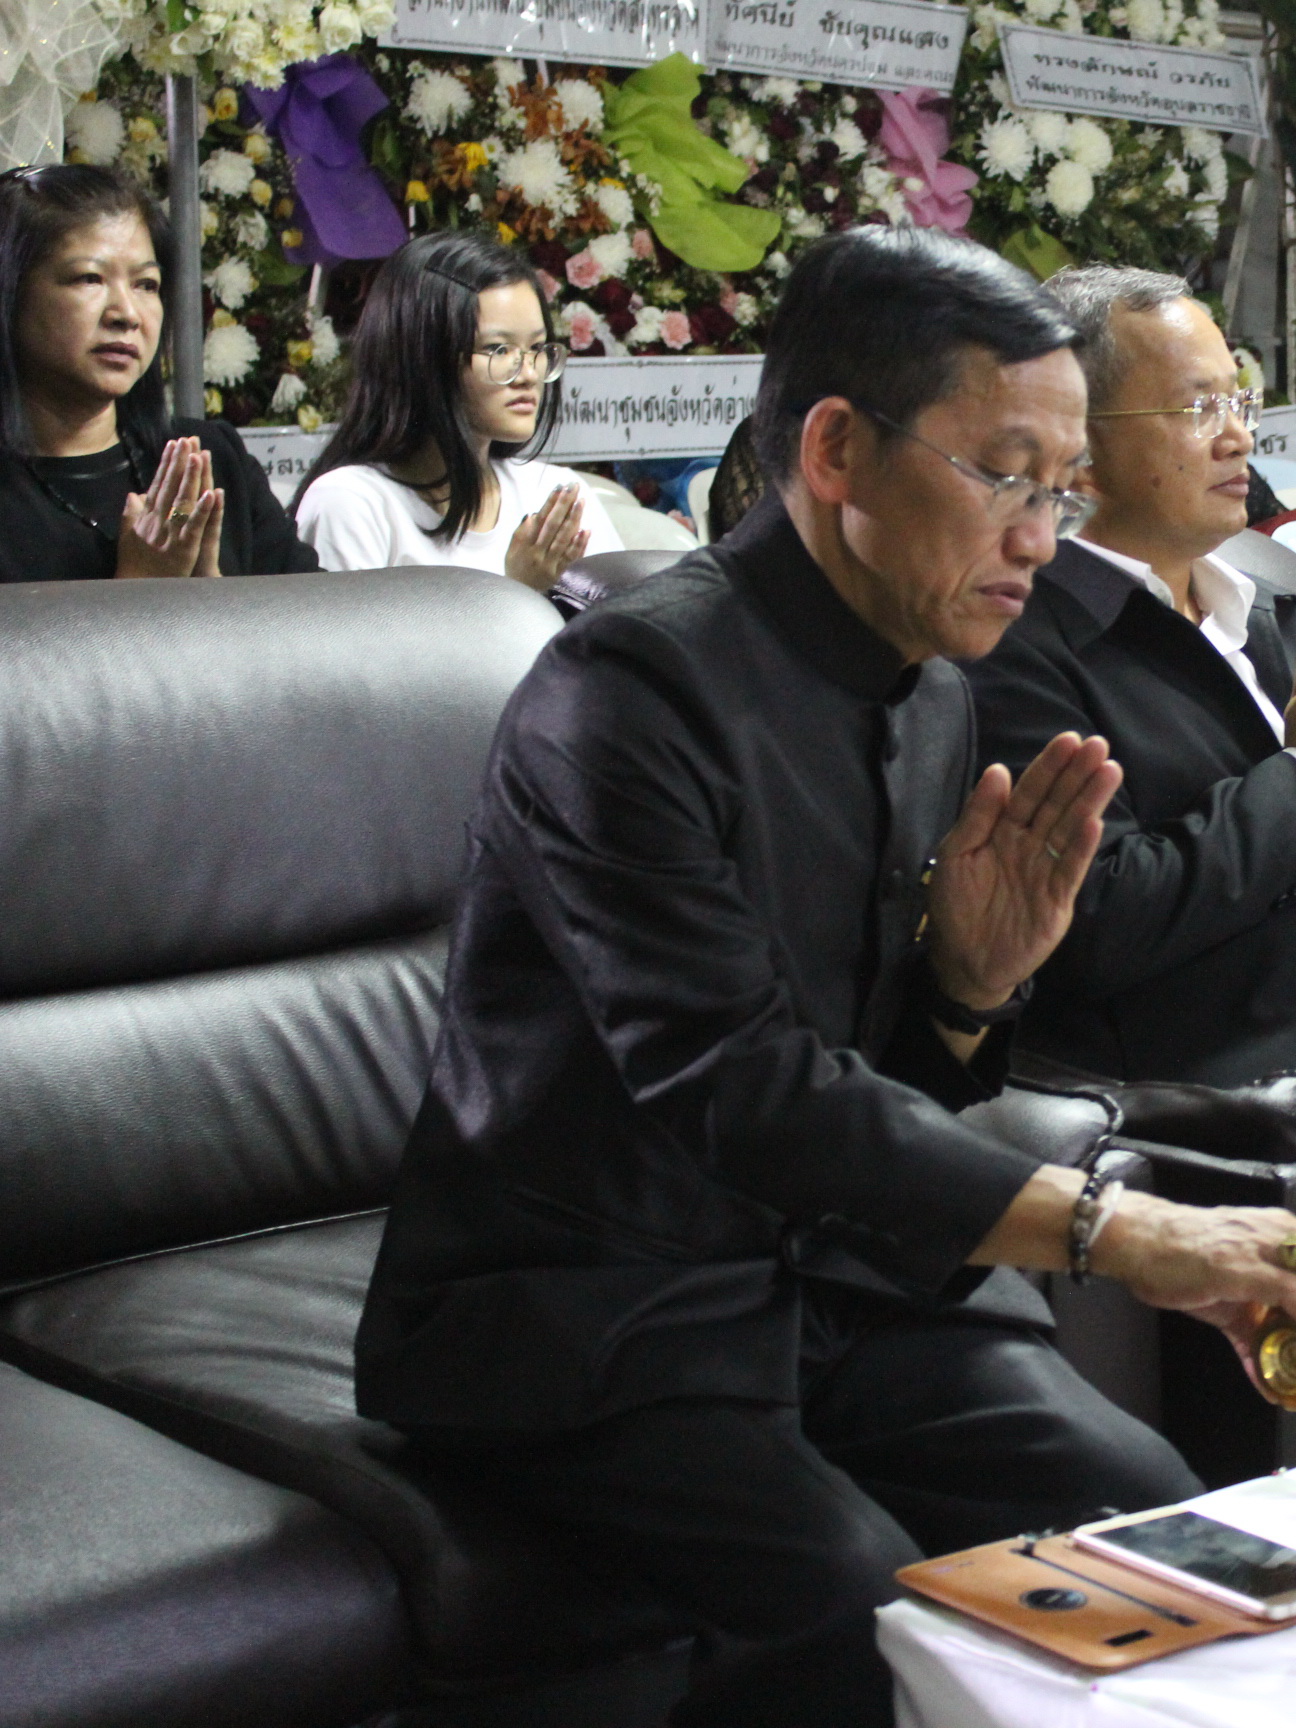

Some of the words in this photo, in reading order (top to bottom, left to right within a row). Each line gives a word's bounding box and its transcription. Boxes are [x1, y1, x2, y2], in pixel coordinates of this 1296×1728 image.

[560, 376, 756, 442] พัฒนาชุมชนจังหวัดอ่าง
